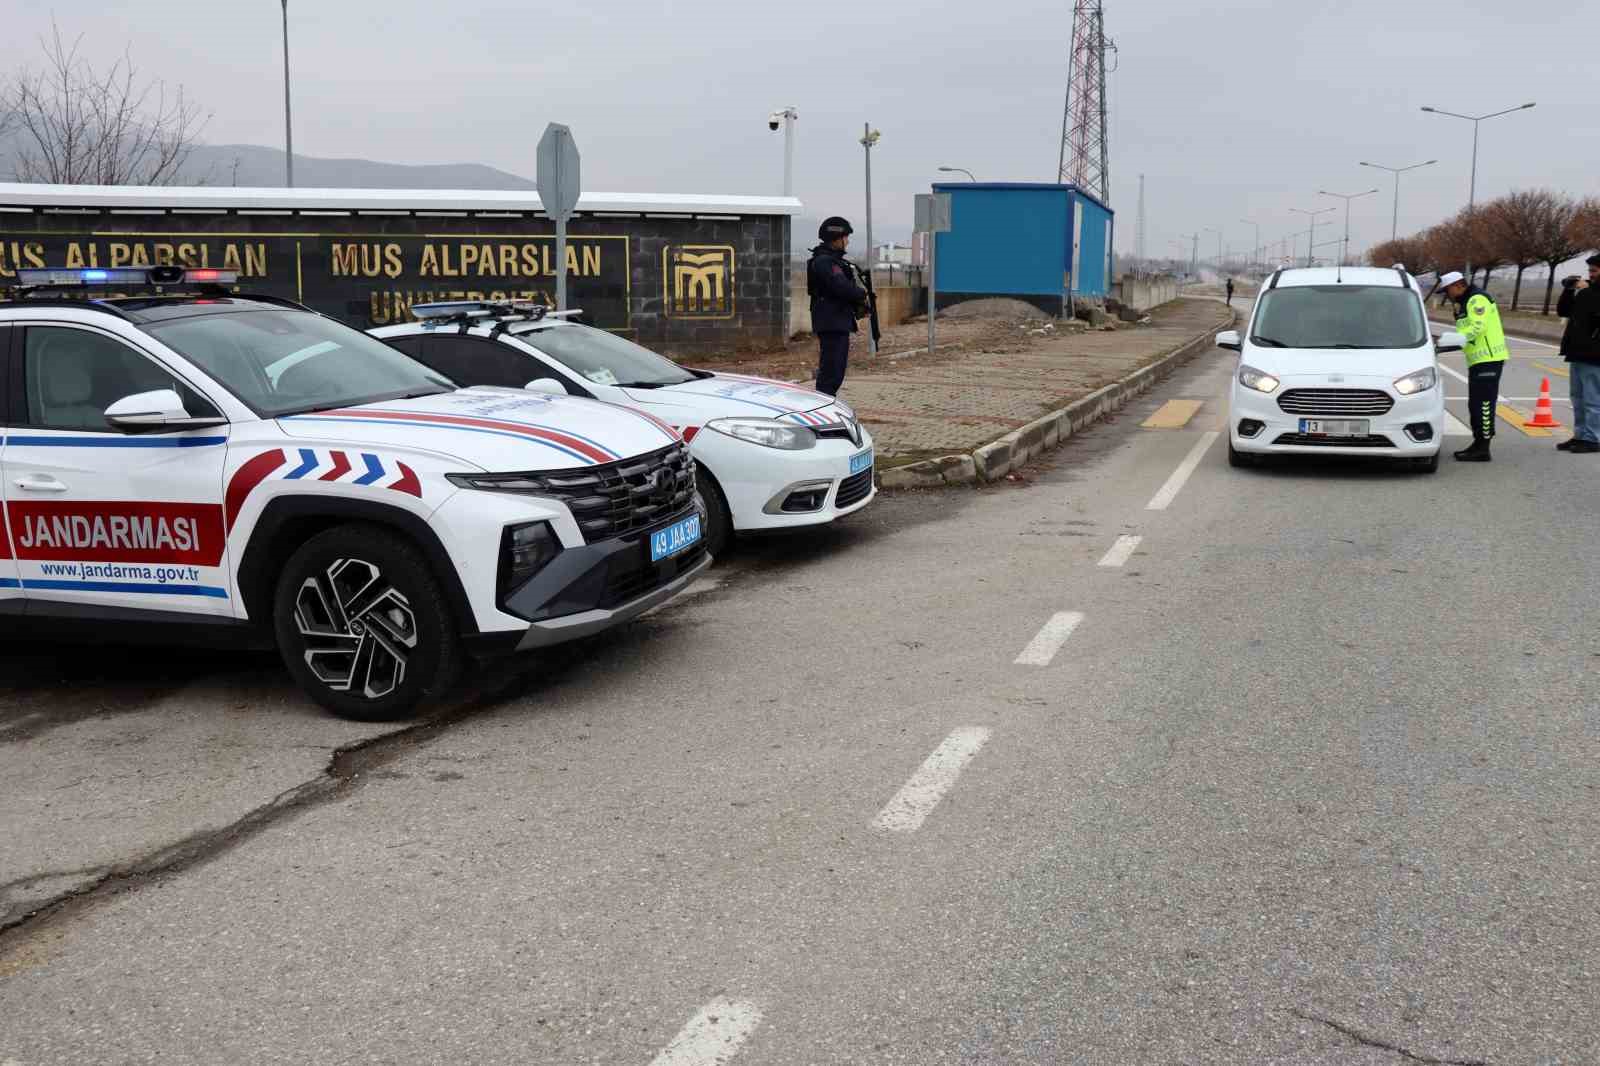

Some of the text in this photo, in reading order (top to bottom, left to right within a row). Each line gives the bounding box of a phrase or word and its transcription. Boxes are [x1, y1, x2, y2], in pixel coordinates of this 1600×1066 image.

[420, 243, 601, 277] ALPARSLAN
[20, 515, 200, 551] JANDARMASI
[656, 532, 667, 554] 49
[685, 517, 699, 541] 307
[41, 562, 199, 583] www.jandarma.gov.tr
